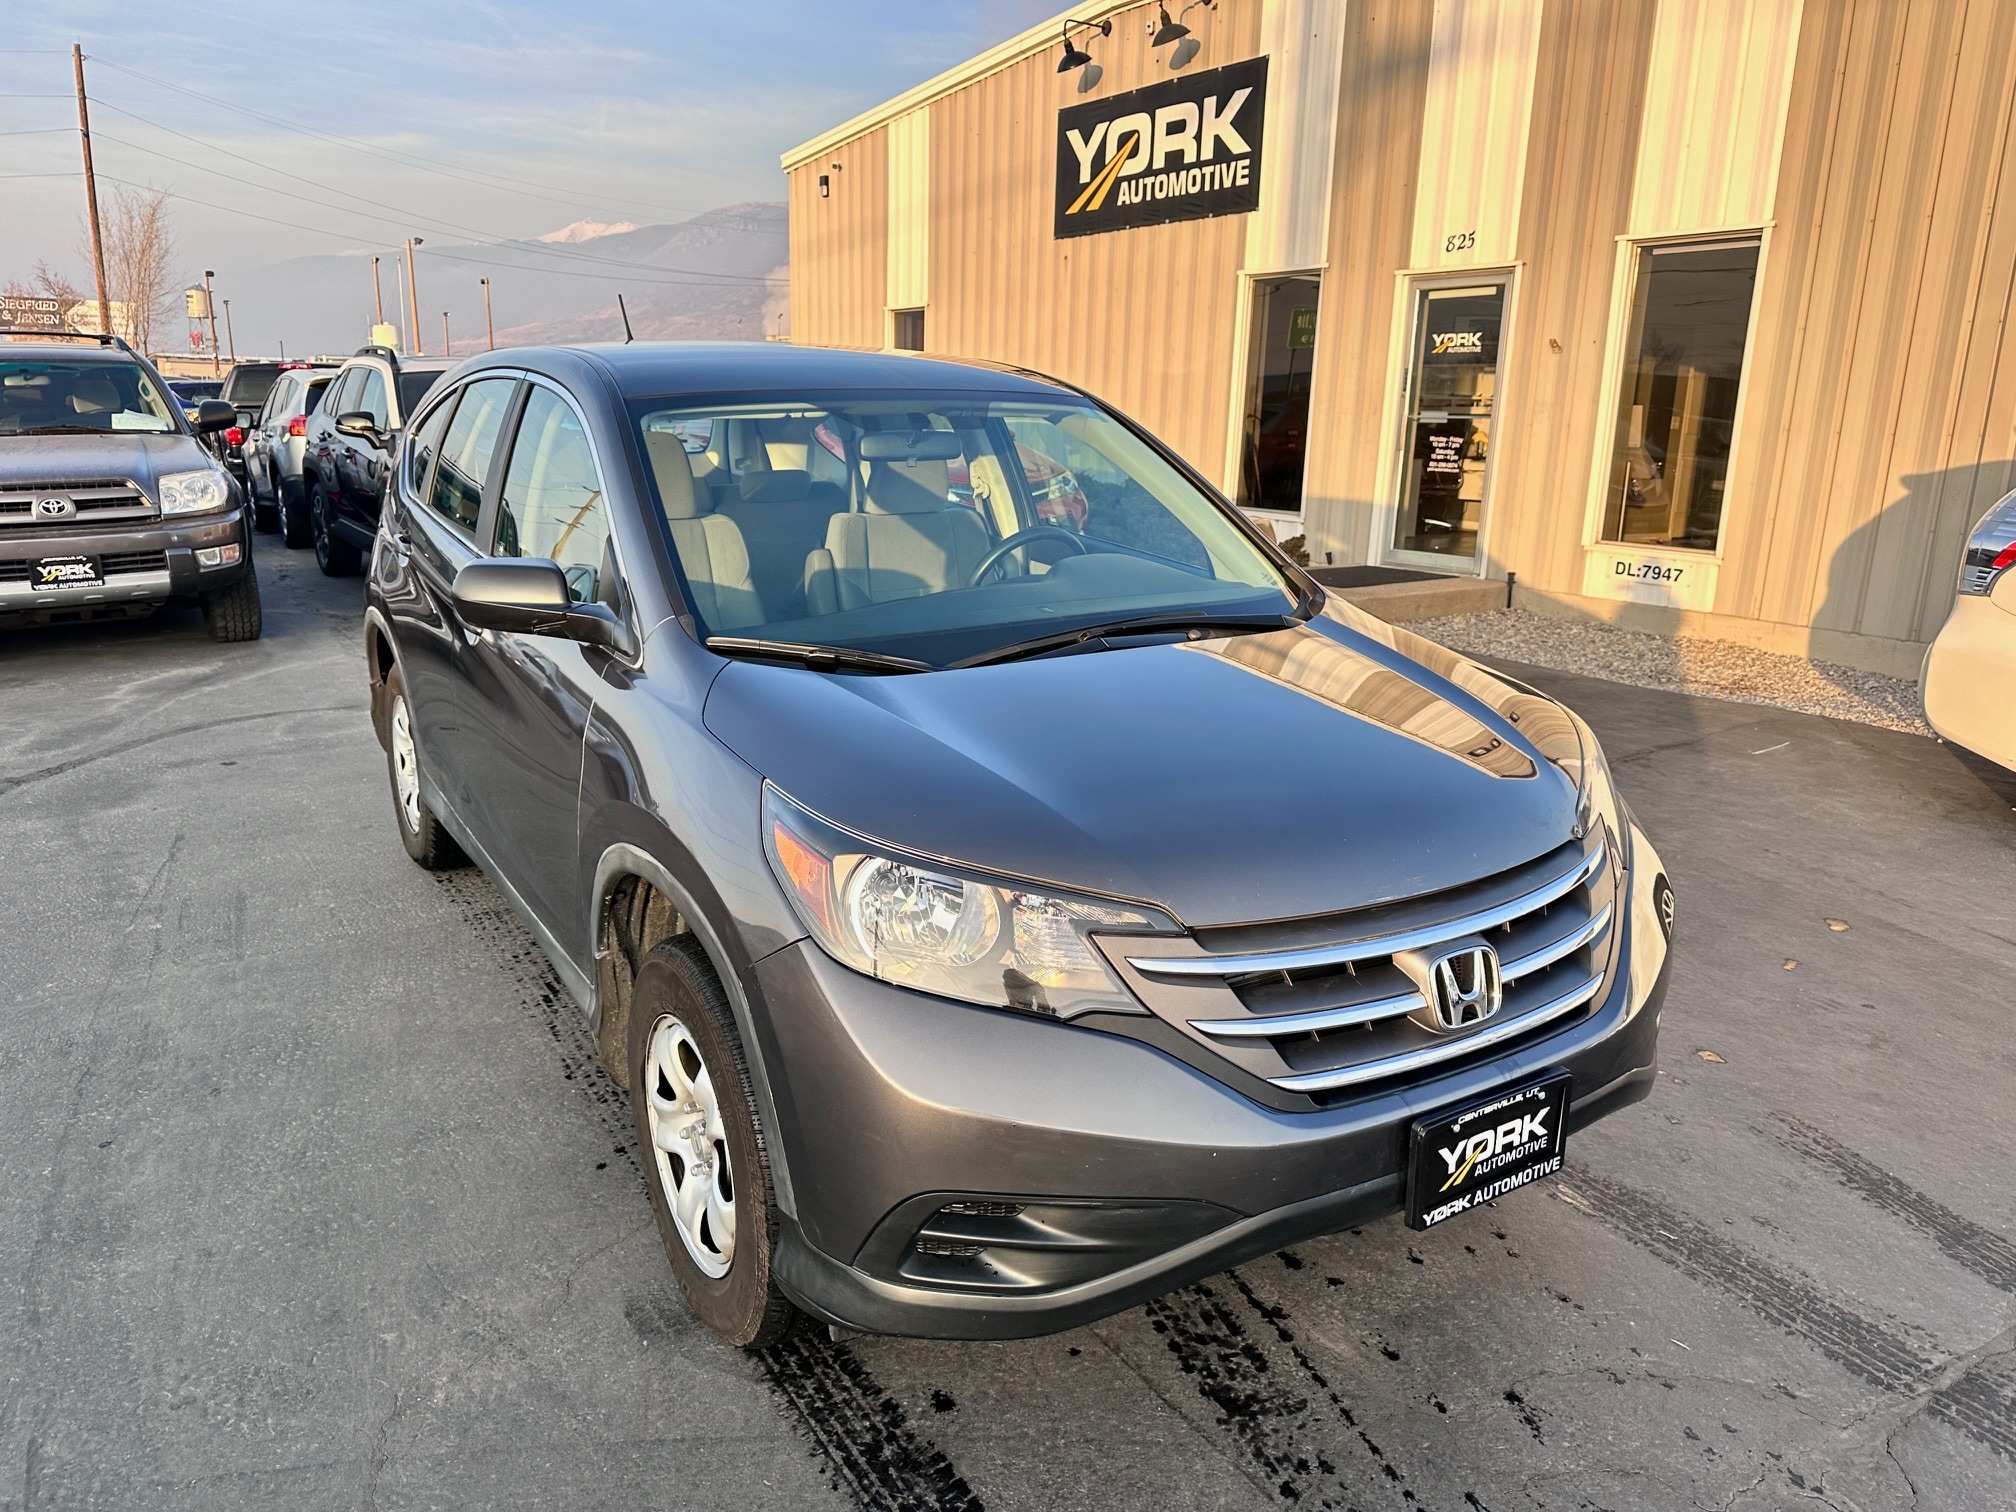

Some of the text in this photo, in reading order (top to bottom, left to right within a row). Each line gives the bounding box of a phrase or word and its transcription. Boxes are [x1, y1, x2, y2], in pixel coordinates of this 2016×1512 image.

[1065, 87, 1254, 184] YORK
[1116, 158, 1251, 206] AUTOMOTIVE
[1445, 230, 1476, 253] 825
[0, 296, 59, 311] SIEGFRIED
[1, 310, 13, 320] &
[14, 310, 60, 325] JENSEN
[1431, 332, 1483, 347] YORK
[1446, 346, 1482, 354] AUTOMOTIVE
[36, 563, 95, 577] YORK
[1615, 561, 1684, 582] DL:7947
[58, 580, 103, 589] AUTOMOTIVE
[1438, 1106, 1551, 1175] YORK
[1474, 1136, 1548, 1177] AUTOMOTIVE
[1422, 1156, 1562, 1227] YORK AUTOMOTIVE
